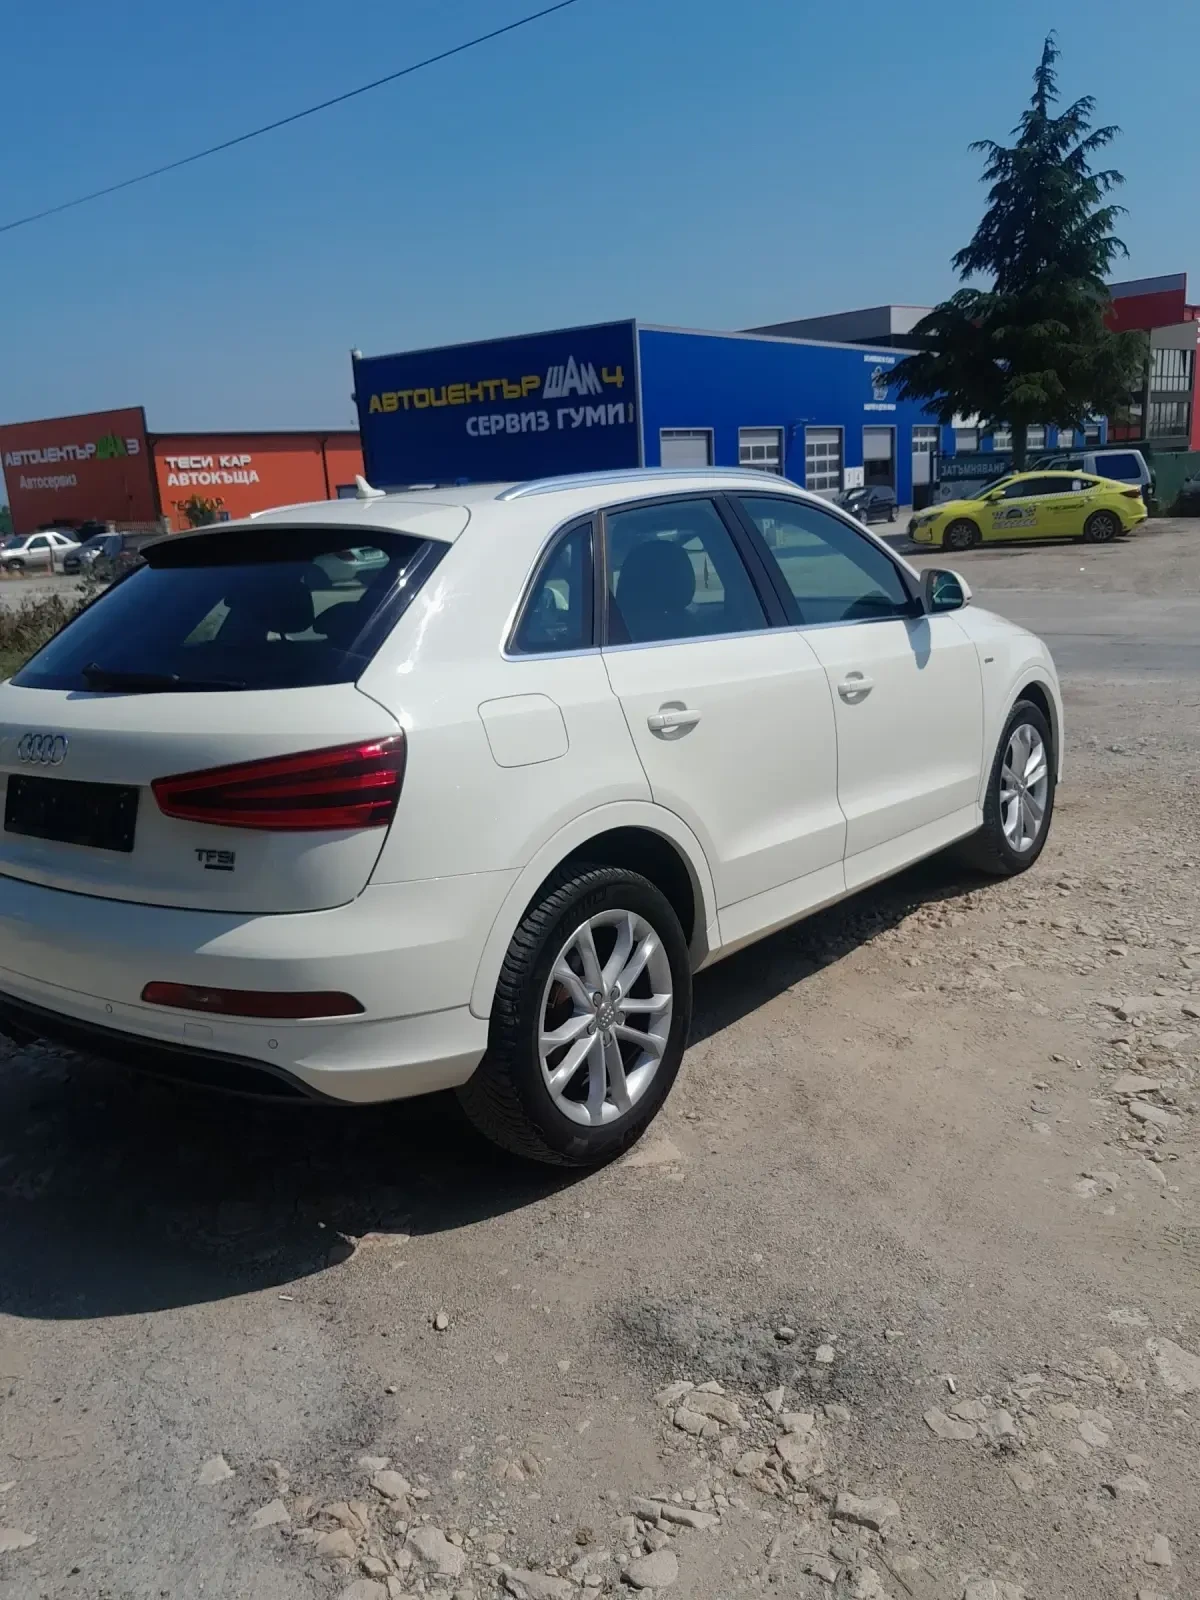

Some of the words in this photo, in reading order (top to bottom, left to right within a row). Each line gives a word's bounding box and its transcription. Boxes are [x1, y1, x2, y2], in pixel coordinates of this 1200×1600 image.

[368, 375, 541, 414] АВТОЦЕНТЪР
[542, 355, 603, 399] ШАМ
[601, 365, 625, 389] 4
[465, 410, 550, 437] СЕРВИЗ
[556, 402, 626, 430] ГУМИ
[5, 442, 97, 467] АВТОЦЕНТЪР
[164, 455, 214, 470] ТЕСИ
[219, 454, 252, 468] КАР
[20, 473, 78, 492] Автосервиз
[167, 470, 260, 488] АВТОКЪЩА
